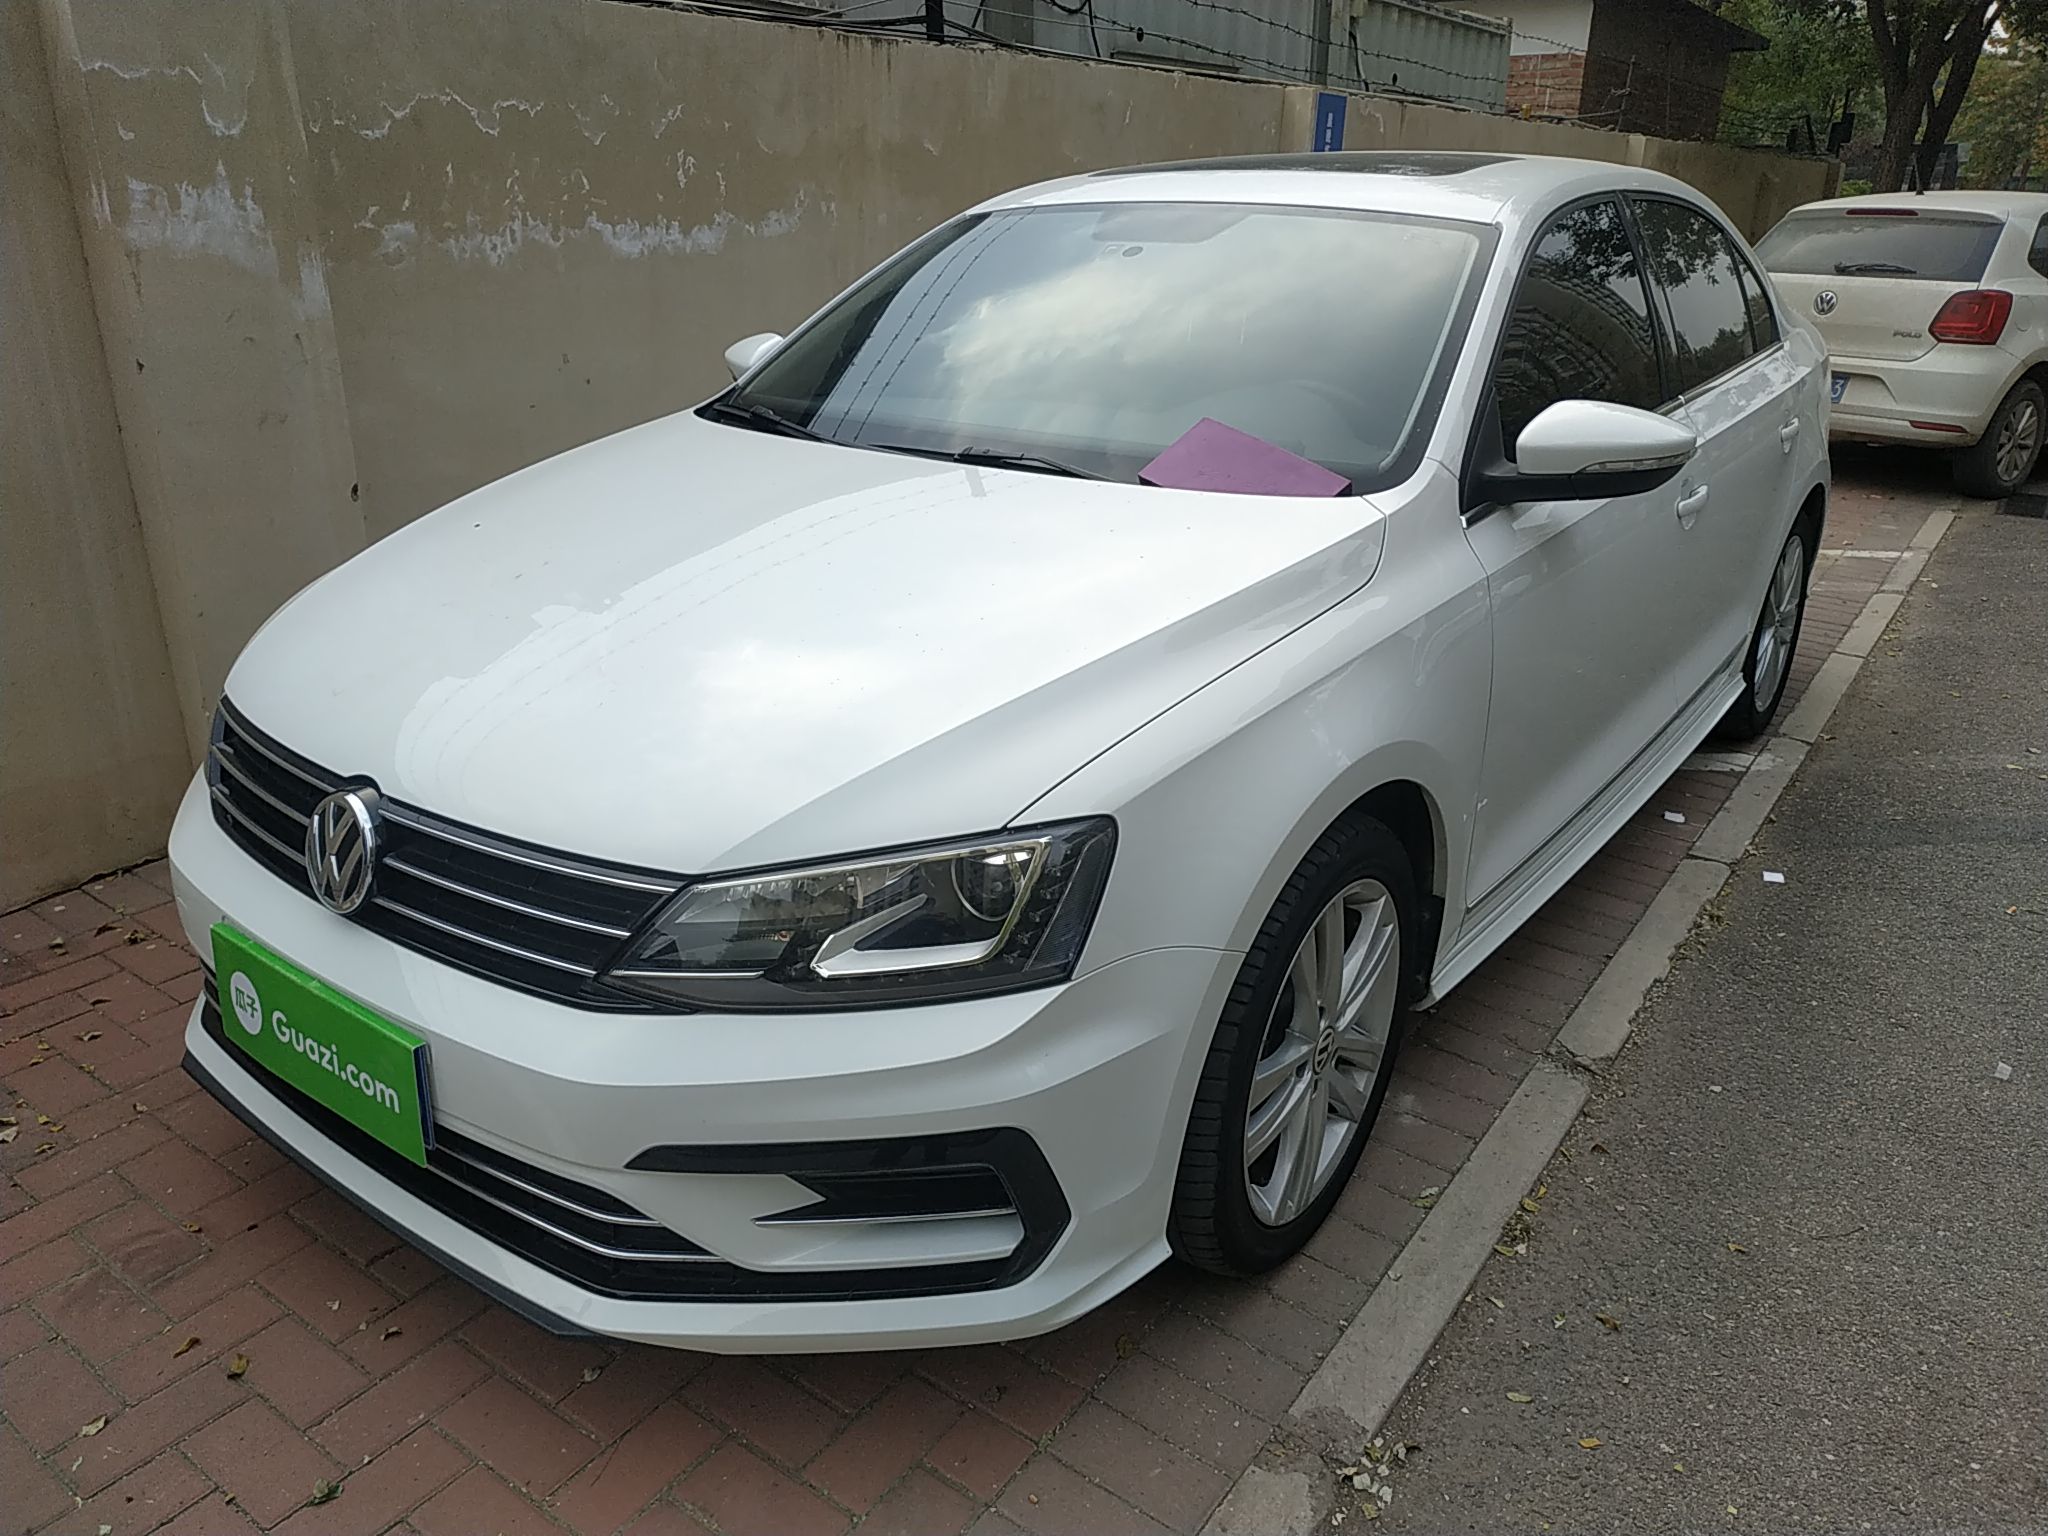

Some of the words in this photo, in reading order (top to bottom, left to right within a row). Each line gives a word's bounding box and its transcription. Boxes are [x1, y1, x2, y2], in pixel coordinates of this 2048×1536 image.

[1892, 329, 1923, 339] POLO
[235, 985, 259, 1020] 瓜子
[272, 1010, 400, 1114] Guazi.com
